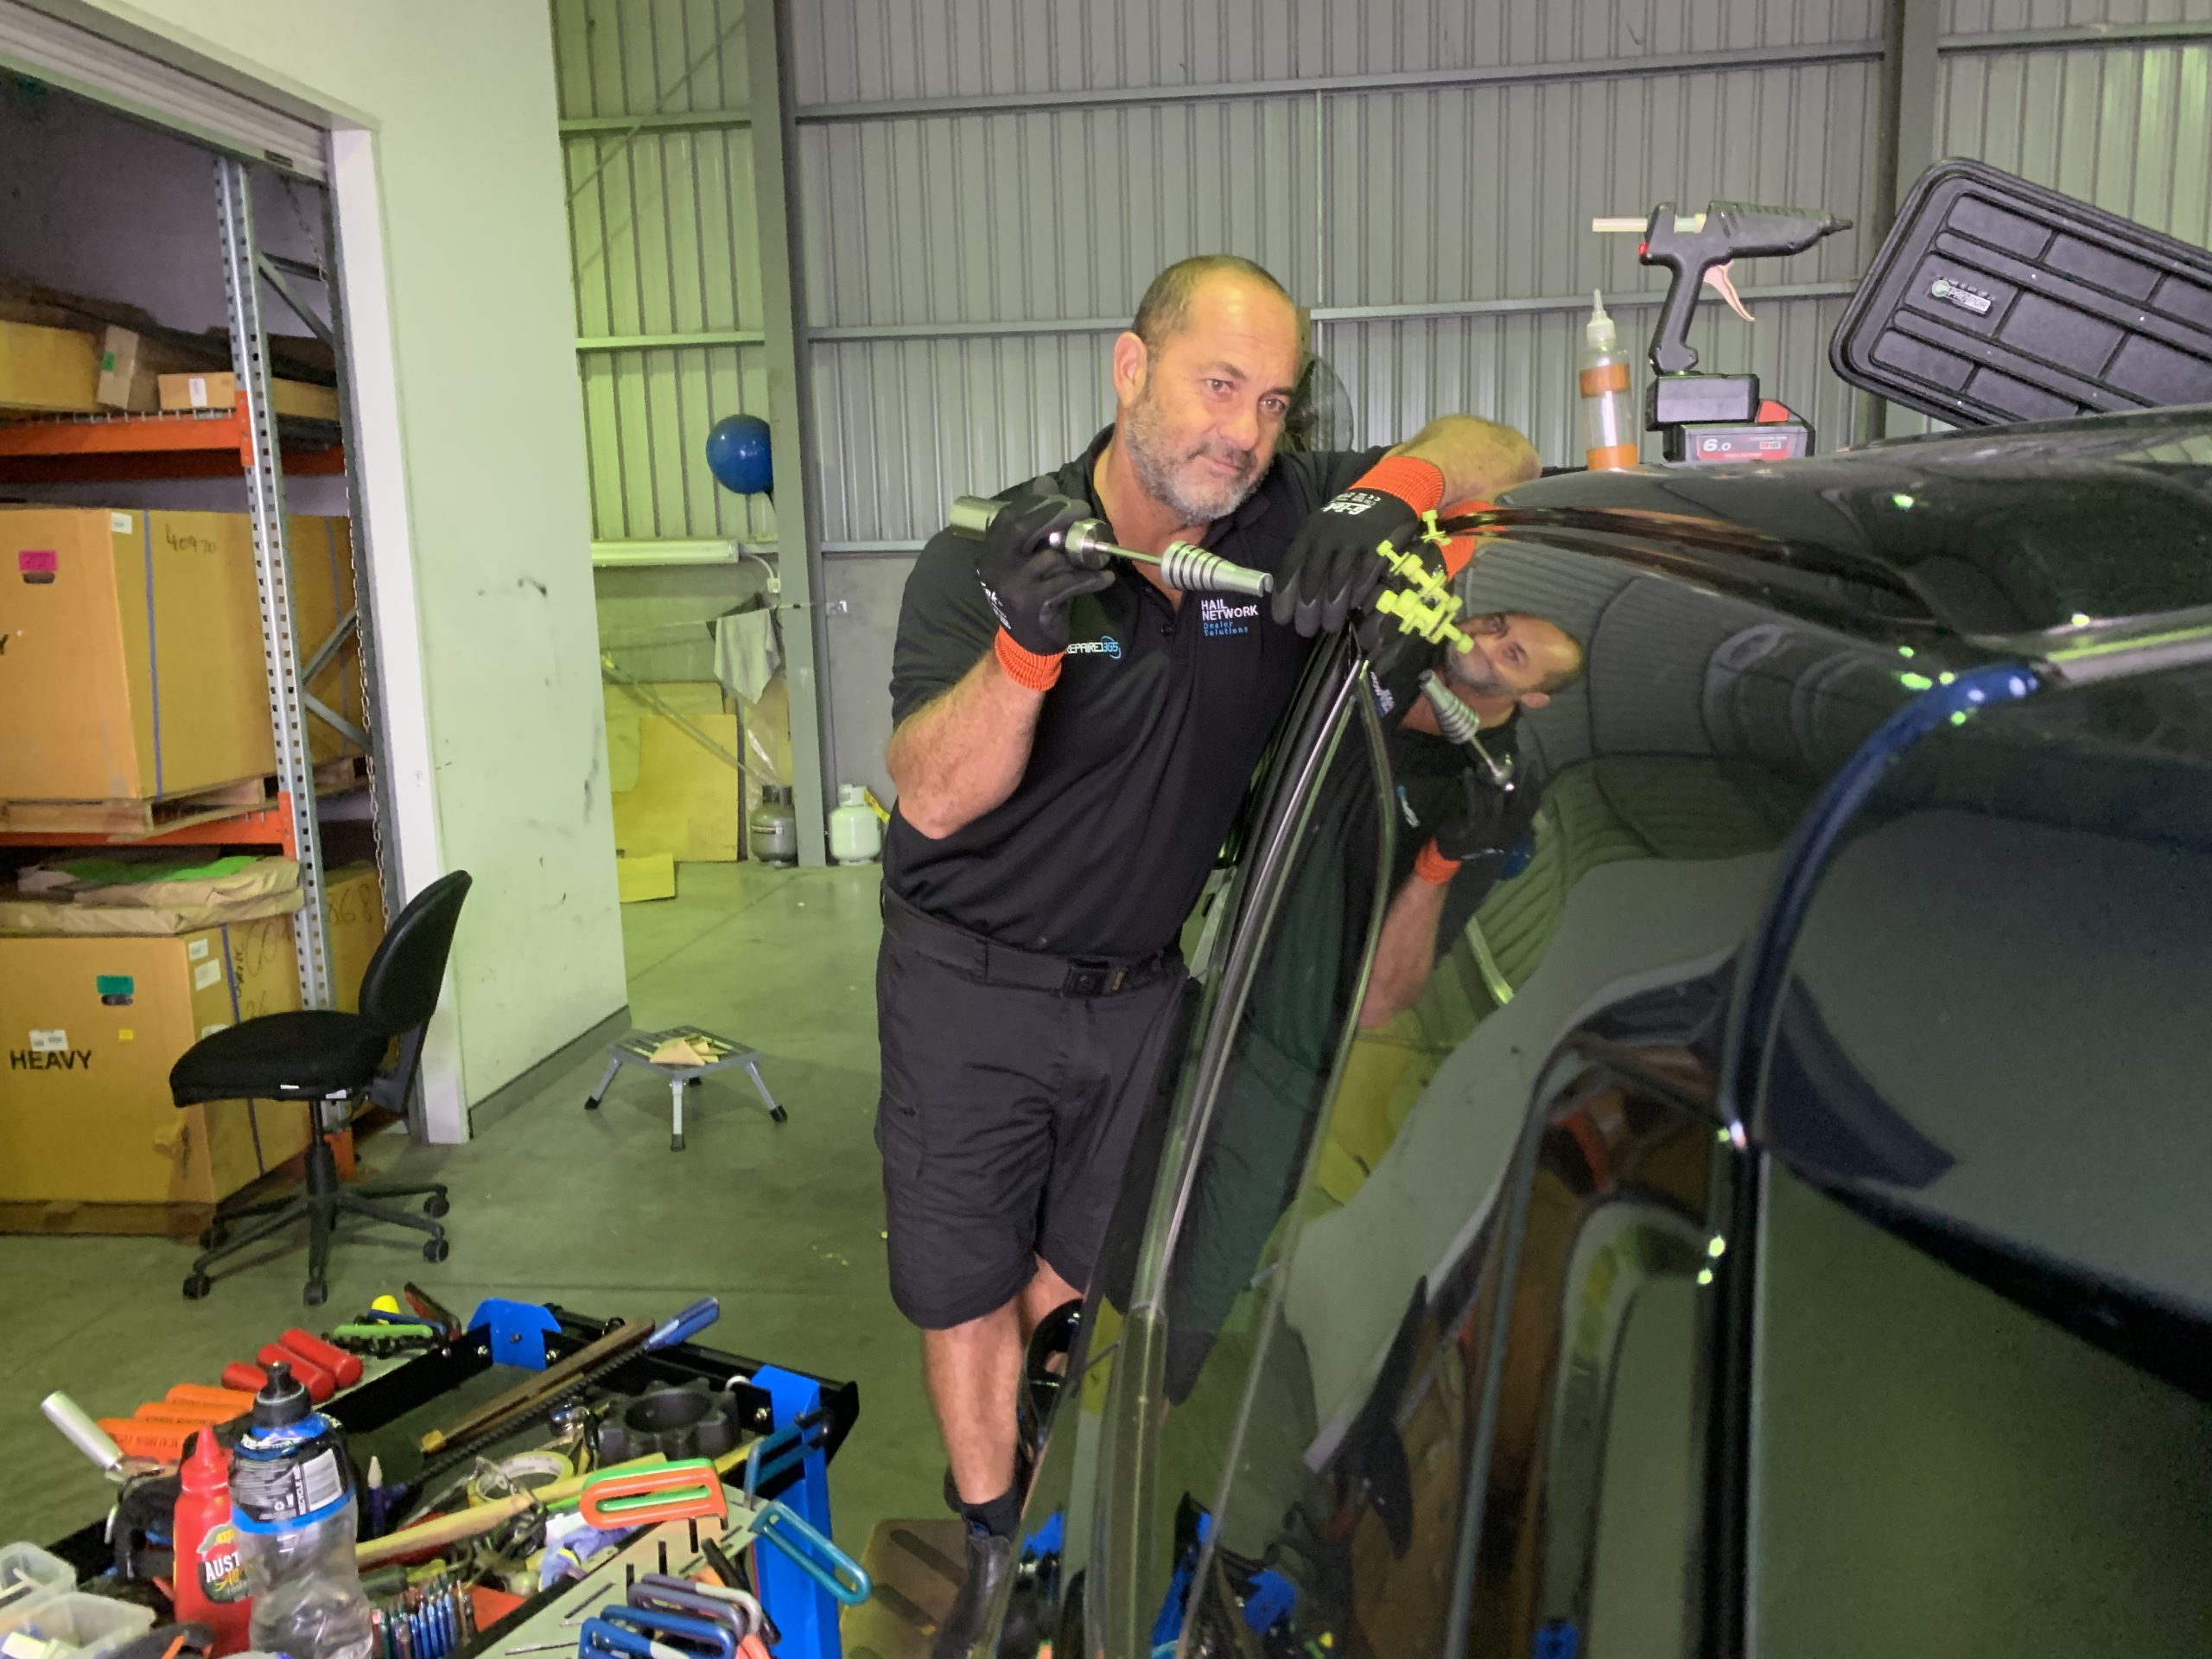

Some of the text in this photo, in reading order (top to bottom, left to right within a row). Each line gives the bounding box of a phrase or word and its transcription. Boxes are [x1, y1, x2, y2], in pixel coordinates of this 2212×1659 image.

[1702, 438, 1732, 452] 6.0
[1201, 599, 1228, 610] HAIL
[1202, 605, 1258, 621] NETWORK
[1203, 621, 1233, 630] Dealer
[1204, 626, 1249, 637] Solutions
[10, 1049, 92, 1070] HEAVY
[205, 1551, 241, 1583] AUST
